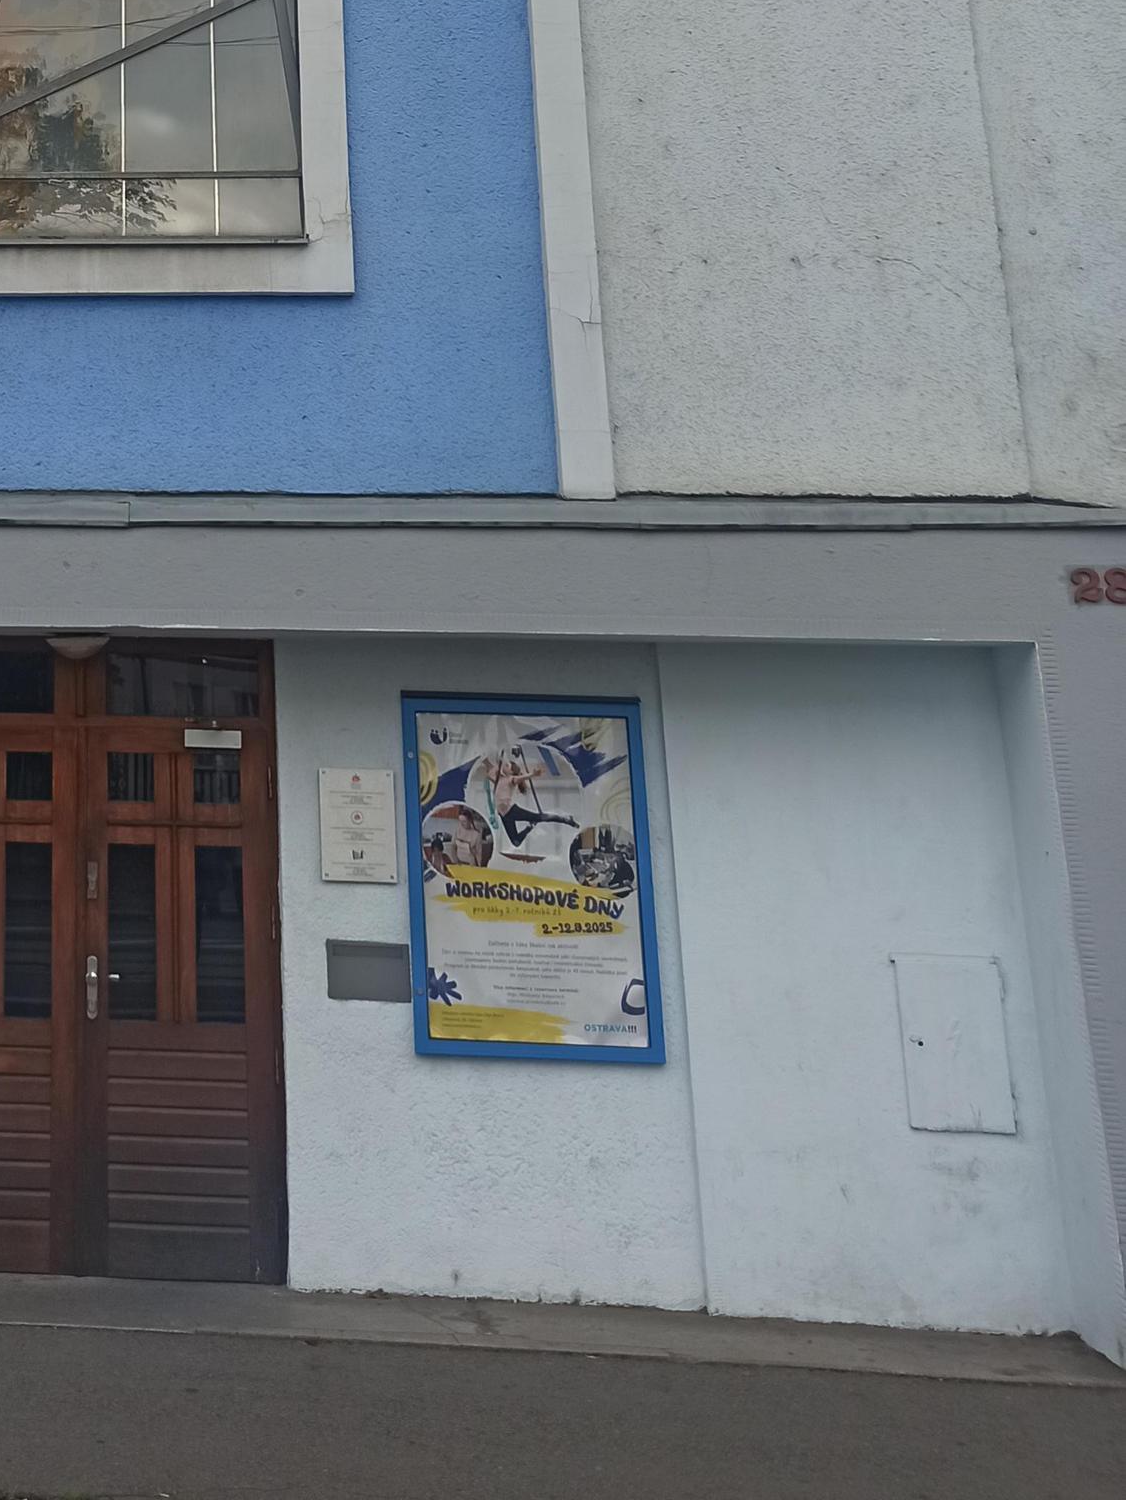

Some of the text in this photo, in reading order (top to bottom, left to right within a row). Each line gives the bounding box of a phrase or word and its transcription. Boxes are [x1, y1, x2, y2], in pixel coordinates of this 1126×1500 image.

[1070, 568, 1126, 606] 28
[445, 880, 625, 920] WORKSHOPOVÉ DNY
[584, 1023, 638, 1034] OSTRAVA!!!
